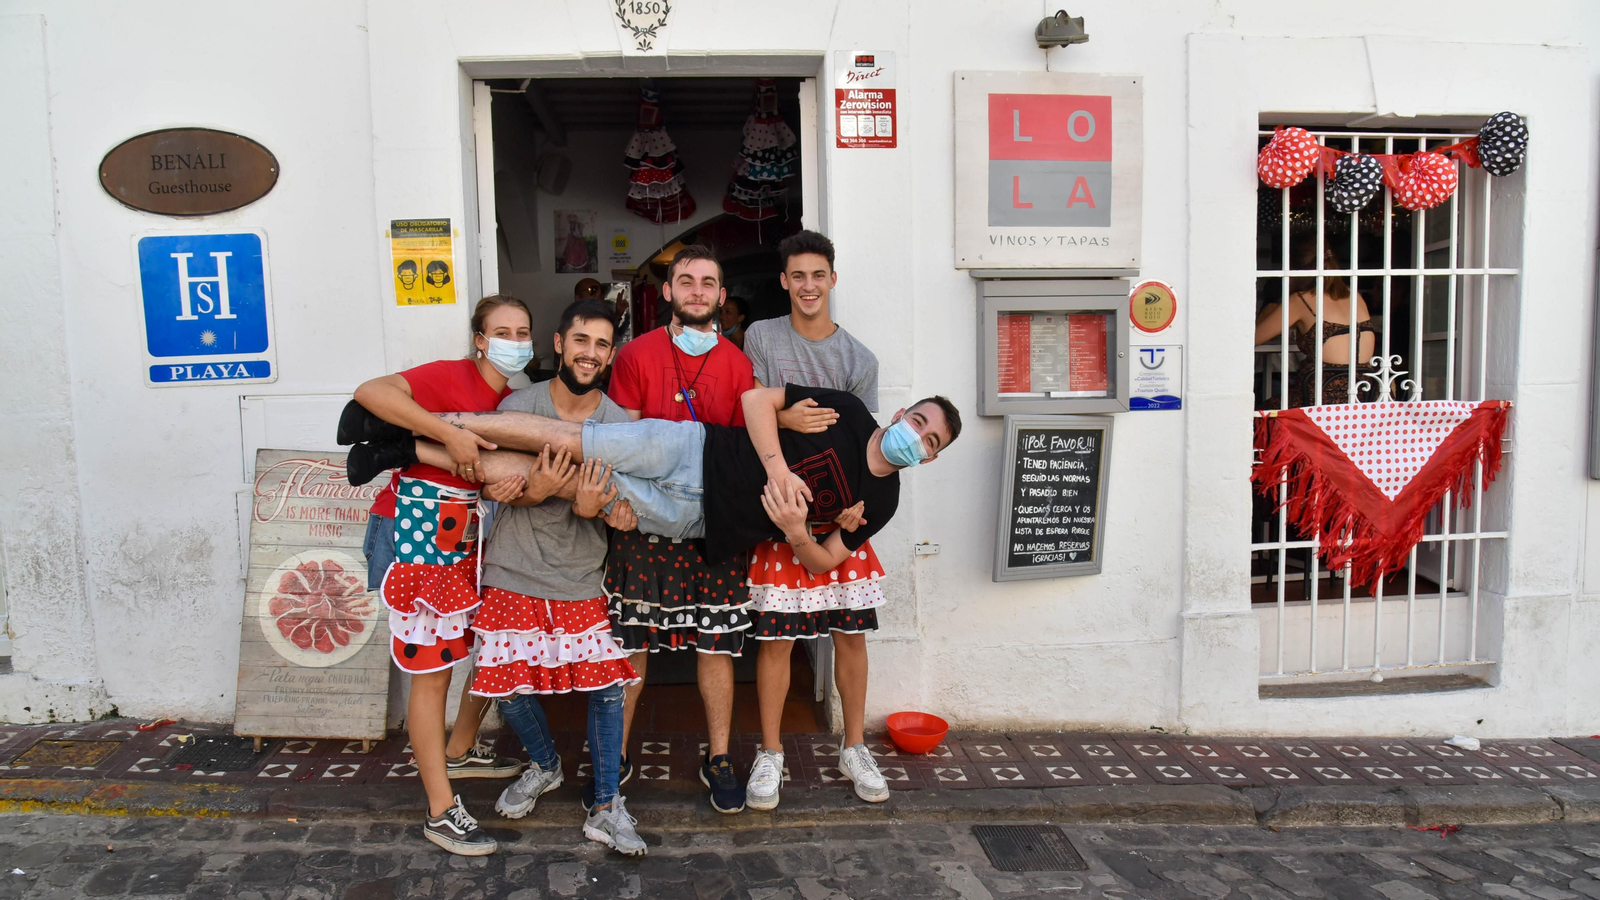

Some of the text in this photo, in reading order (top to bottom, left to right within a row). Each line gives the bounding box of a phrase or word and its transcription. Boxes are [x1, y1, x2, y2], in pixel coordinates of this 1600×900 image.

[628, 1, 660, 15] 1850
[846, 66, 885, 84] Direct
[848, 89, 883, 99] Alarma
[840, 99, 892, 109] Zerovision
[150, 153, 226, 171] BENALI
[148, 179, 232, 195] Guesthouse
[989, 235, 1110, 247] VINOS Y TAPAS
[169, 363, 250, 381] PLAYA
[1023, 457, 1047, 469] TENED
[1022, 473, 1091, 483] SEGUID LAS NORMAS
[254, 458, 383, 523] Flamenco
[1021, 487, 1078, 497] Y PASADLO BIEN
[286, 505, 296, 519] IS
[299, 506, 331, 520] MORE
[333, 507, 360, 521] THAN
[1052, 505, 1072, 513] CERCA
[1075, 505, 1080, 513] Y
[1083, 505, 1091, 513] OS
[1016, 516, 1059, 524] APUNTAREMOS
[1062, 516, 1071, 524] EN
[308, 524, 343, 538] MUSIC
[1046, 527, 1068, 535] ESPERA
[1071, 526, 1090, 535] PORQUE
[1013, 541, 1090, 551] NO HACEMOS RESERVAS
[252, 666, 296, 683] Pata
[354, 674, 370, 685] HAM
[263, 694, 283, 704] FRIED
[284, 695, 300, 704] KING
